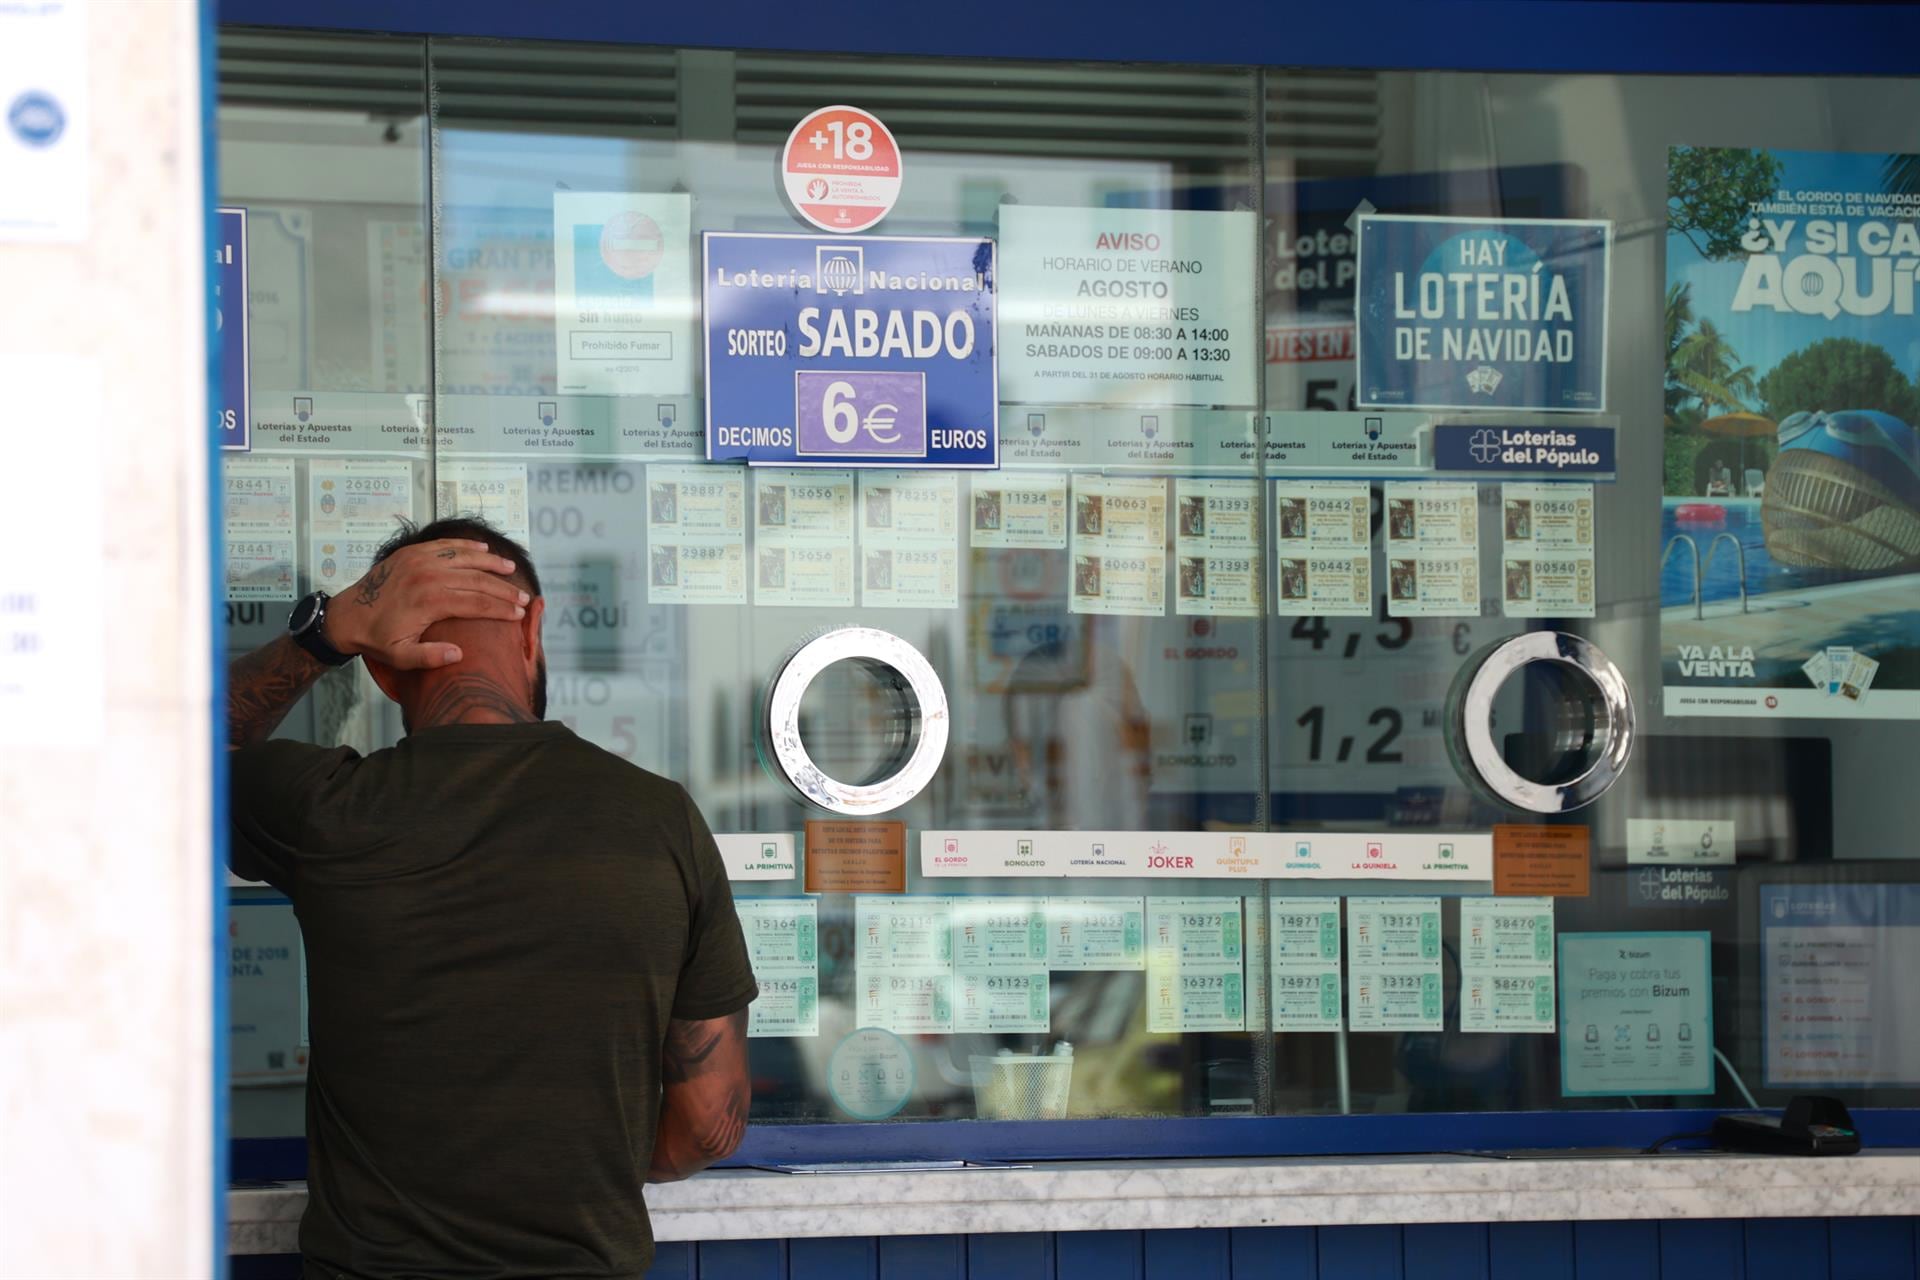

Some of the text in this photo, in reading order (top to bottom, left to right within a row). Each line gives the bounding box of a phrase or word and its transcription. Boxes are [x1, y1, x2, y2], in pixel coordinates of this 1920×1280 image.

[809, 121, 873, 160] +18
[833, 164, 890, 172] RESPONSABILIDAD
[1778, 191, 1920, 205] EL GORDO DE NAVIDAD
[1750, 201, 1807, 214] TAMBIÉN
[1809, 203, 1844, 216] ESTÁ
[1846, 205, 1865, 216] DE
[1741, 218, 1796, 252] ¿Y
[1805, 220, 1848, 254] SI
[1096, 233, 1160, 251] AVISO
[1461, 239, 1507, 266] HAY
[1043, 257, 1202, 274] HORARIO DE VERANO
[718, 268, 984, 291] Lotería Nacional
[1077, 280, 1168, 299] AGOSTO
[1395, 260, 1573, 321] LOTERÍA
[1138, 306, 1200, 321] VIERNES
[728, 307, 975, 360] SORTEO SABADO
[1026, 322, 1229, 341] MAÑANAS DE 08:30 A 14:00
[581, 340, 660, 351] Prohibido Fumar
[1395, 327, 1574, 362] DE NAVIDAD
[1026, 344, 1231, 361] SABADOS DE 09:00 A 13:30
[1072, 371, 1087, 379] DEL
[1112, 372, 1145, 380] AGOSTO
[1147, 373, 1183, 381] HORARIO
[307, 424, 352, 433] Apuestas
[552, 427, 595, 437] Apuestas
[297, 435, 330, 443] Estado
[524, 439, 574, 447] del Estado
[719, 427, 792, 447] DECIMOS
[931, 429, 987, 449] EUROS
[1040, 439, 1081, 448] Apuestas
[644, 440, 693, 448] del Estado
[1153, 440, 1194, 450] Apuestas
[1265, 441, 1306, 450] Apuestas
[1377, 442, 1416, 451] Apuestas
[1014, 449, 1061, 457] del Estado
[1128, 450, 1174, 459] del Estado
[1368, 453, 1398, 461] Estado
[1502, 448, 1599, 467] del Pópulo
[345, 480, 390, 489] 26200
[790, 488, 832, 498] 15656
[1006, 493, 1047, 504] 11934
[1105, 499, 1146, 510] 40663
[1209, 500, 1250, 510] 21393
[1310, 501, 1350, 511] 90442
[1534, 503, 1575, 513] 00540
[1209, 560, 1250, 571] 21393
[1311, 562, 1351, 572] 90442
[1534, 563, 1575, 573] 00540
[1678, 645, 1756, 661] YA A LA
[1678, 661, 1756, 678] VENTA
[1147, 856, 1193, 869] JOKER
[1662, 886, 1683, 900] del
[756, 919, 797, 930] 15164
[1182, 916, 1222, 927] 16372
[1280, 916, 1320, 927] 14971
[1381, 916, 1421, 927] 13121
[1494, 918, 1535, 929] 58470
[1588, 968, 1681, 983] Paga y cobra tus
[987, 977, 1030, 988] 61123
[1183, 977, 1223, 988] 16372
[1280, 977, 1320, 988] 14971
[1382, 977, 1422, 988] 13121
[1494, 978, 1535, 989] 58470
[1581, 985, 1690, 999] premios con Bizum
